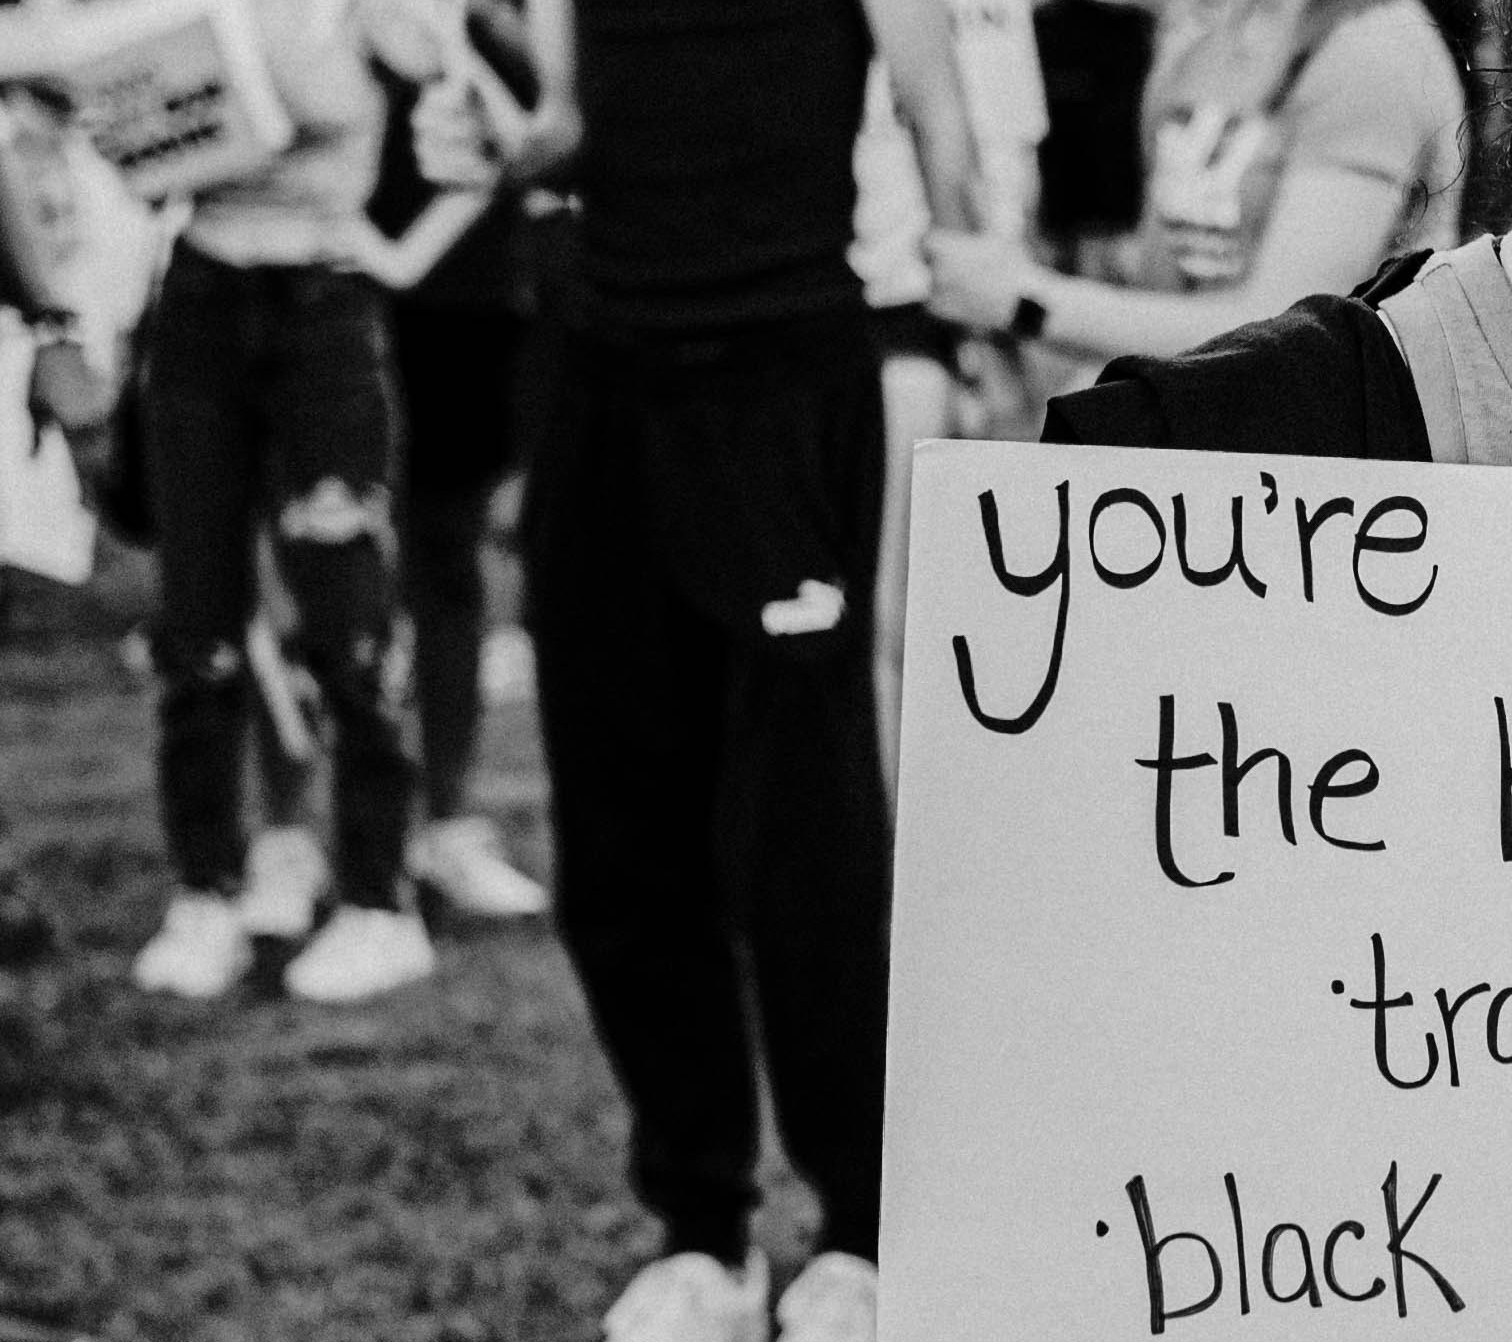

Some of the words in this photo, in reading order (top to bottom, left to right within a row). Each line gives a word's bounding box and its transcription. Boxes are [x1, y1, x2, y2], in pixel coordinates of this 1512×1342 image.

[952, 472, 1440, 736] you're
[1135, 692, 1388, 889] the
[1124, 1160, 1467, 1336] black
